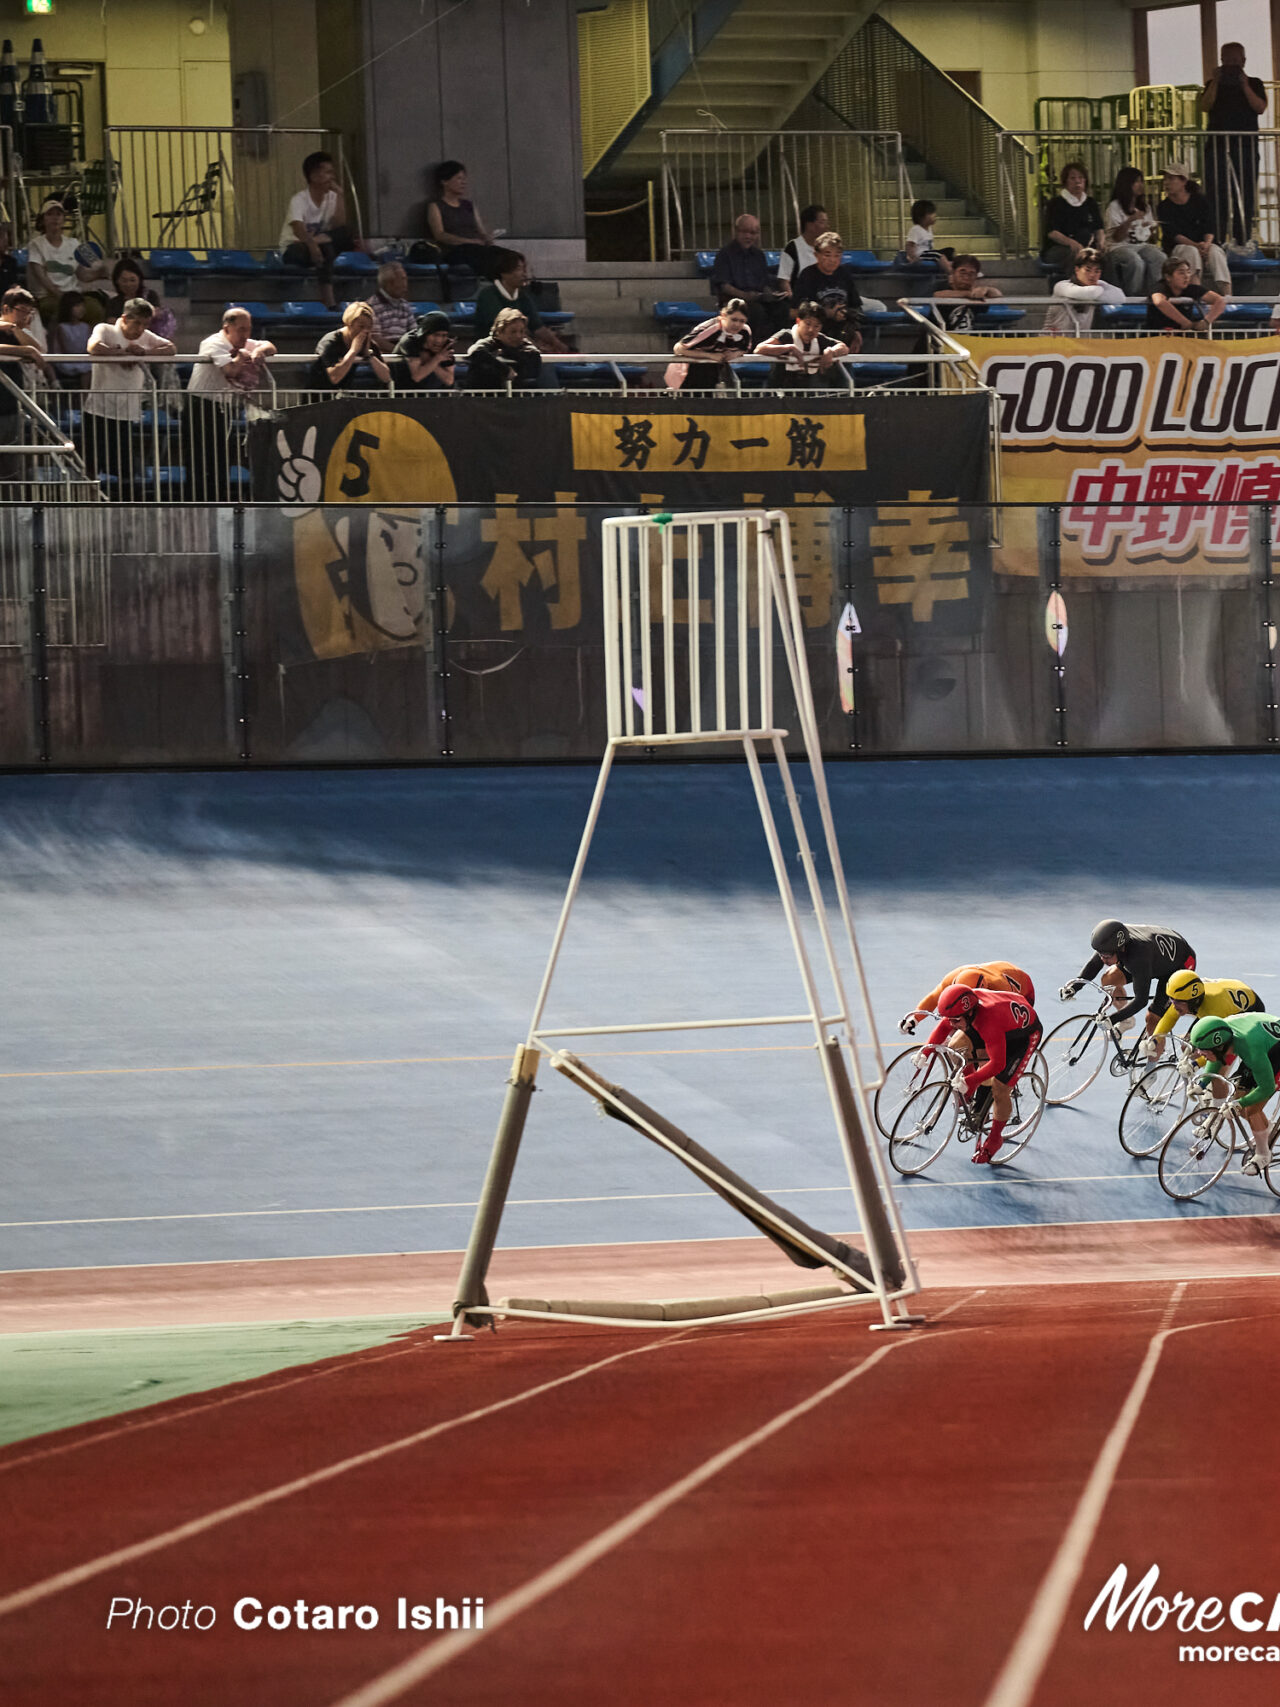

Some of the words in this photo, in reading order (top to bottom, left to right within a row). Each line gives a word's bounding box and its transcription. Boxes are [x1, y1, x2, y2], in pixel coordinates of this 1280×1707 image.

[985, 359, 1144, 435] GOOD
[614, 415, 827, 471] 努力一筋
[339, 428, 381, 498] 5
[1116, 930, 1126, 948] 2
[1154, 933, 1178, 962] 2
[961, 995, 971, 1011] 3
[1190, 983, 1200, 998] 5
[1226, 988, 1251, 1011] 5
[1009, 1000, 1032, 1029] 3
[1212, 1031, 1223, 1046] 6
